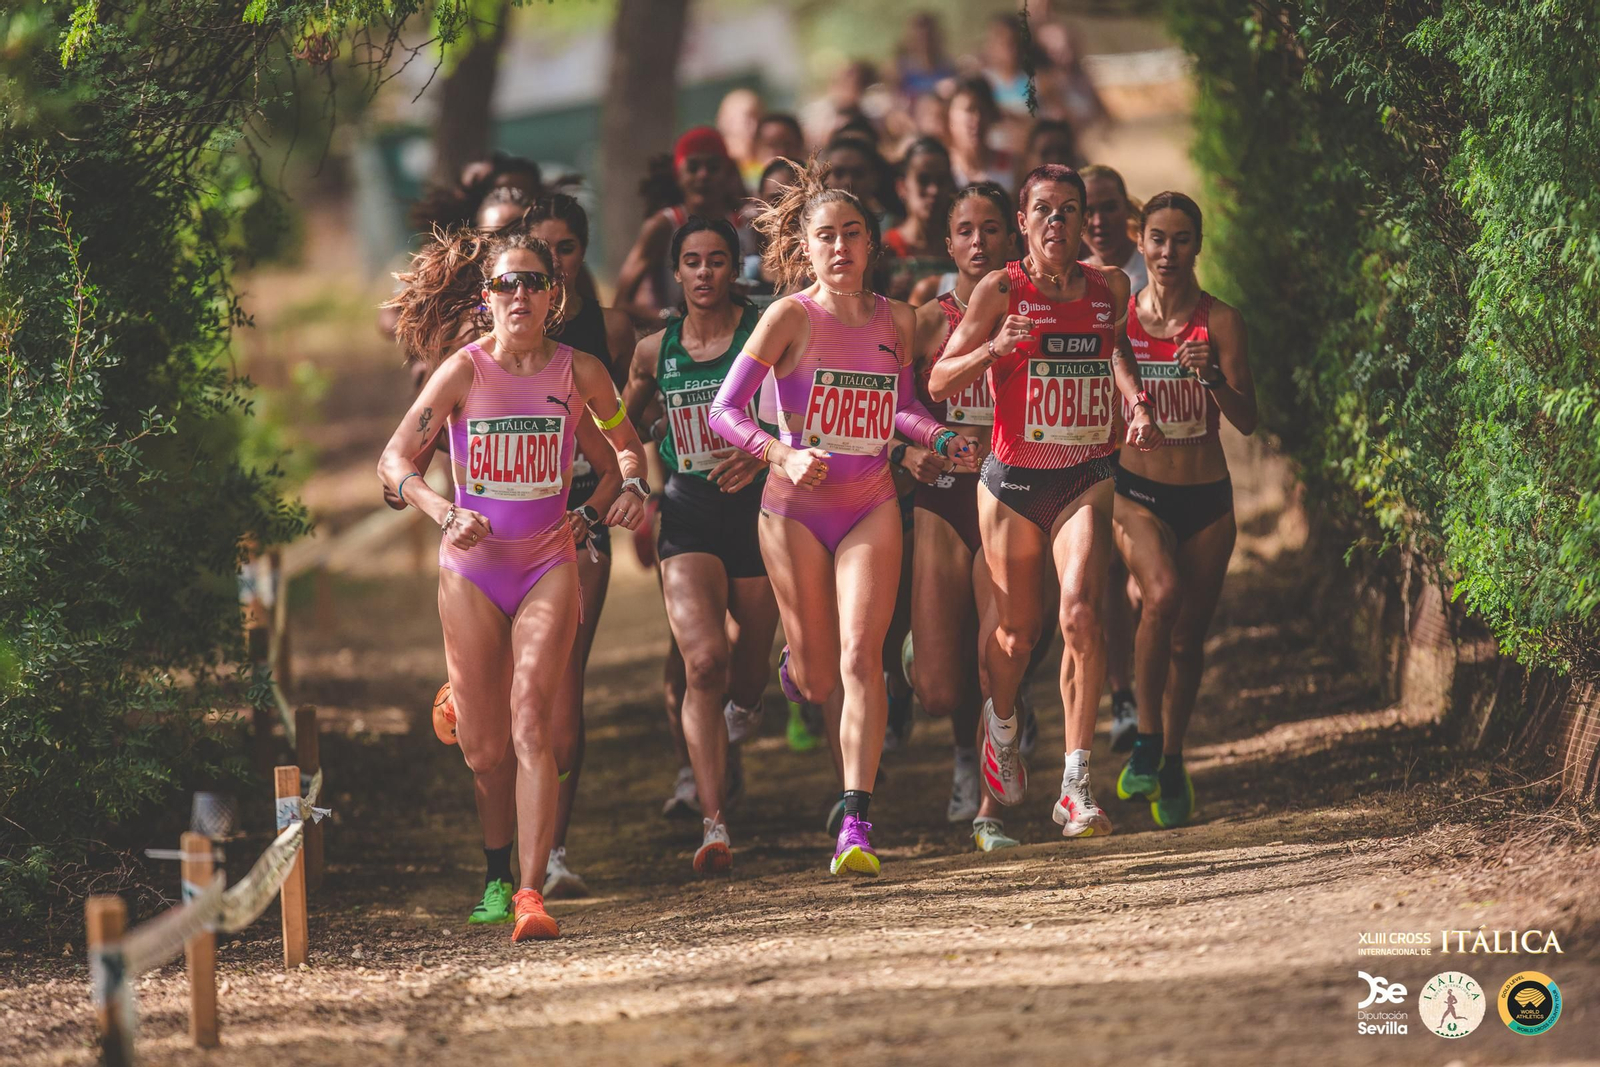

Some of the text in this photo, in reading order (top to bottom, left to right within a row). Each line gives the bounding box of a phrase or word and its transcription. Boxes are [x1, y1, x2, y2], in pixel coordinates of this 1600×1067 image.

[1018, 300, 1052, 315] Bilbao
[1066, 337, 1097, 353] BM
[1055, 362, 1095, 375] ITÁLICA
[839, 373, 879, 387] ITÁLICA
[1027, 377, 1111, 428] ROBLES
[805, 385, 894, 441] FORERO
[495, 418, 539, 431] ITÁLICA
[470, 433, 558, 484] GALLARDO
